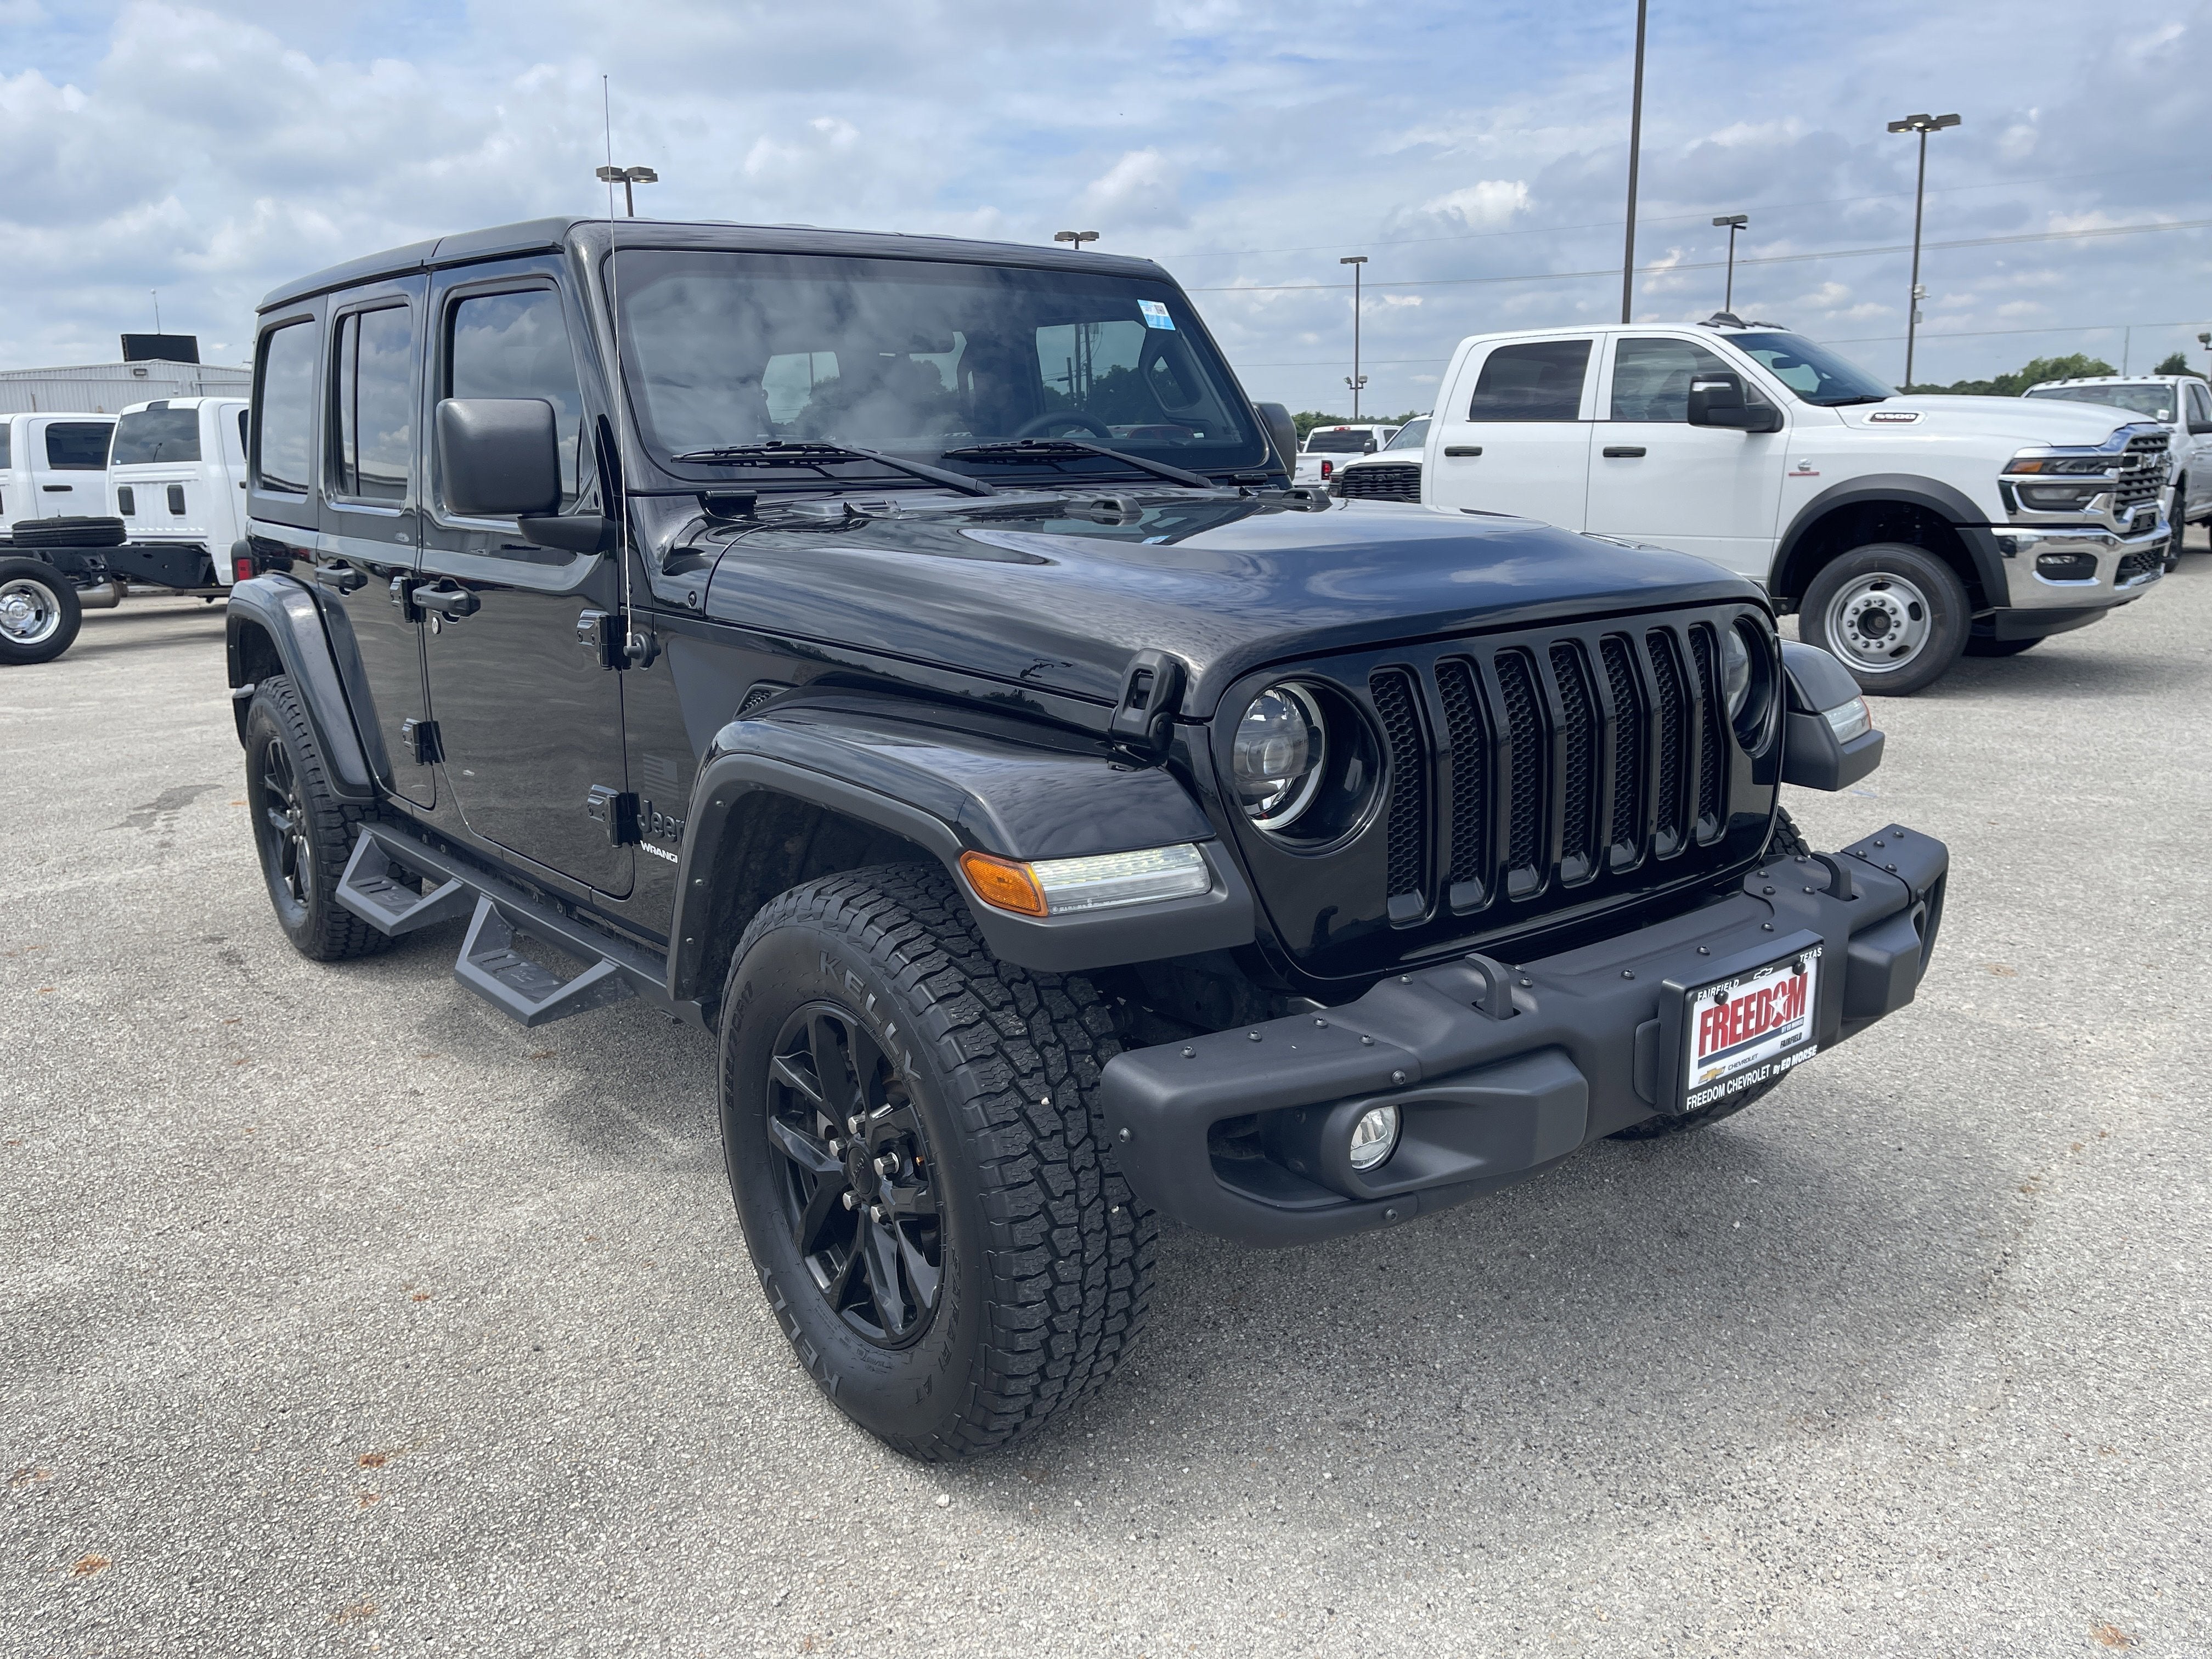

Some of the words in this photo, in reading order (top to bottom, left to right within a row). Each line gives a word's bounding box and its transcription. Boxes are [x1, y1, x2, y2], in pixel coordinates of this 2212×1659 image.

[1697, 979, 1740, 1002] FAIRFIELD
[1800, 947, 1822, 962] TEXAS
[819, 950, 923, 1080] KELLY
[1699, 972, 1808, 1058] FREEDOM
[1686, 1083, 1725, 1111] FREEDOM
[1726, 1064, 1771, 1094] CHEVROLET
[1781, 1057, 1791, 1071] ED
[1791, 1045, 1818, 1066] MORSE
[1728, 1053, 1758, 1070] CHEVROLET
[755, 1260, 843, 1397] KELLY
